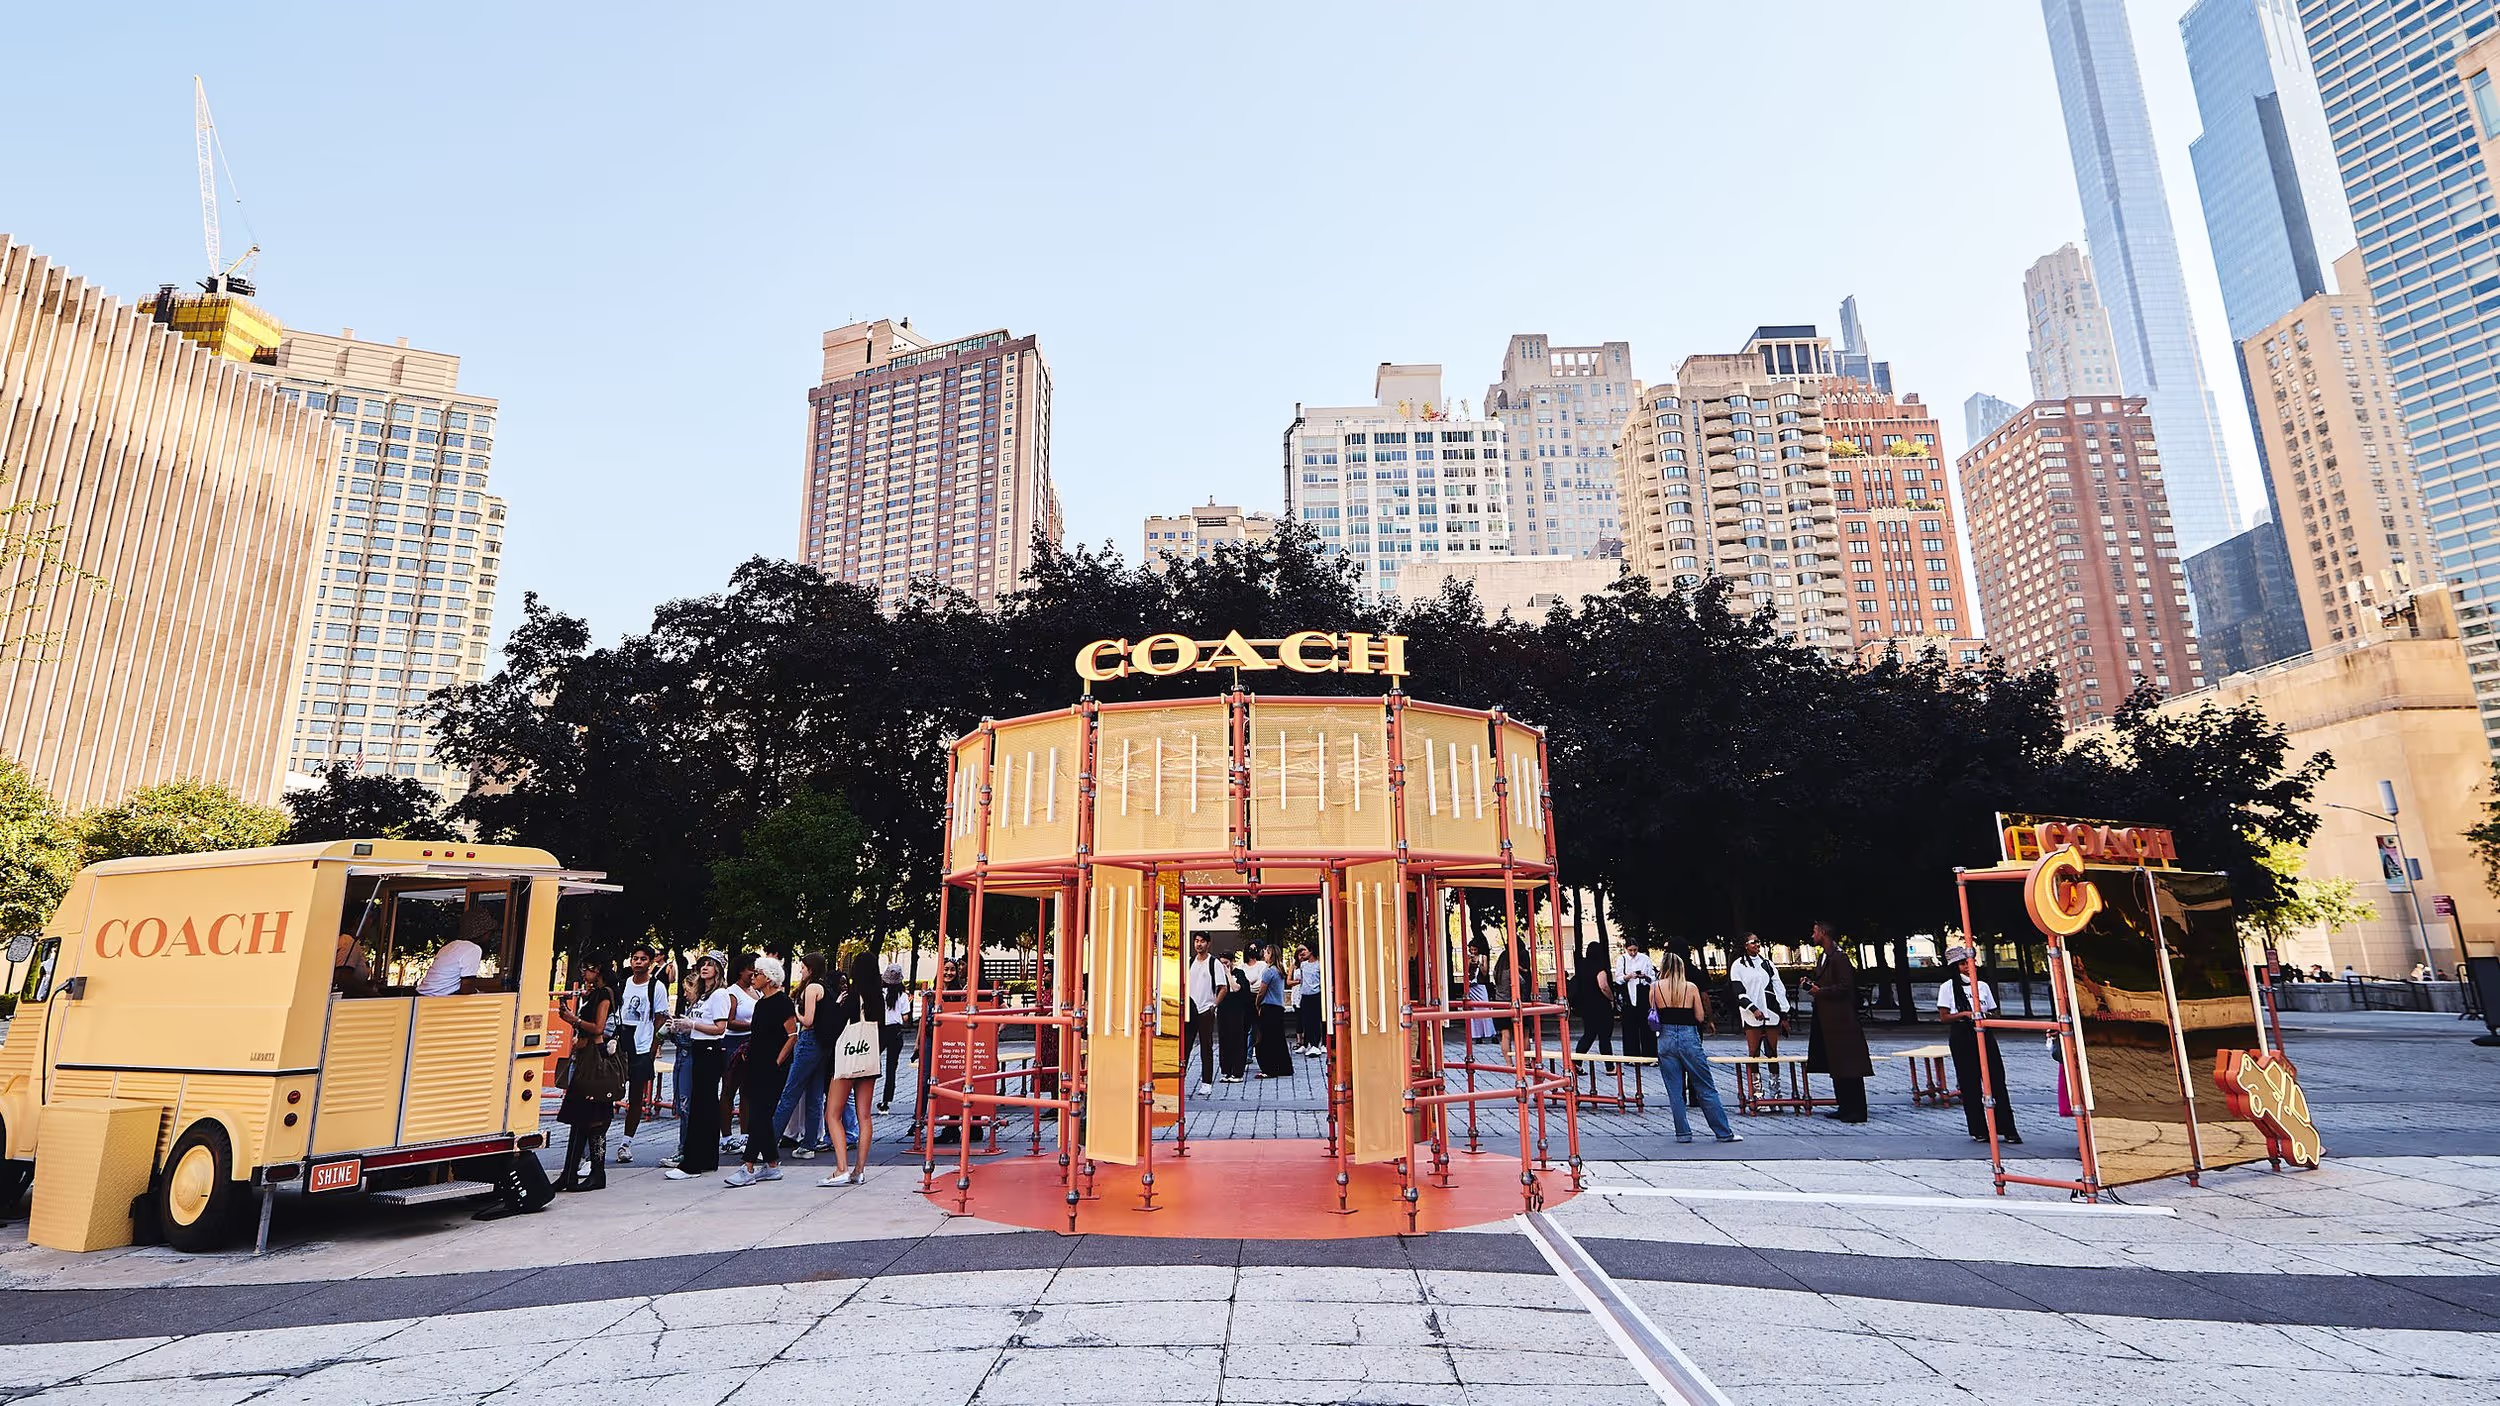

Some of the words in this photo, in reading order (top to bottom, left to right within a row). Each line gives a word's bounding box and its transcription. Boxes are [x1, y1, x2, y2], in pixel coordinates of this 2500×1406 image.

[1074, 629, 1410, 681] COACH
[2039, 822, 2179, 860] COACH
[95, 910, 293, 959] COACH
[843, 1040, 871, 1056] folk
[317, 1165, 353, 1186] SHINE
